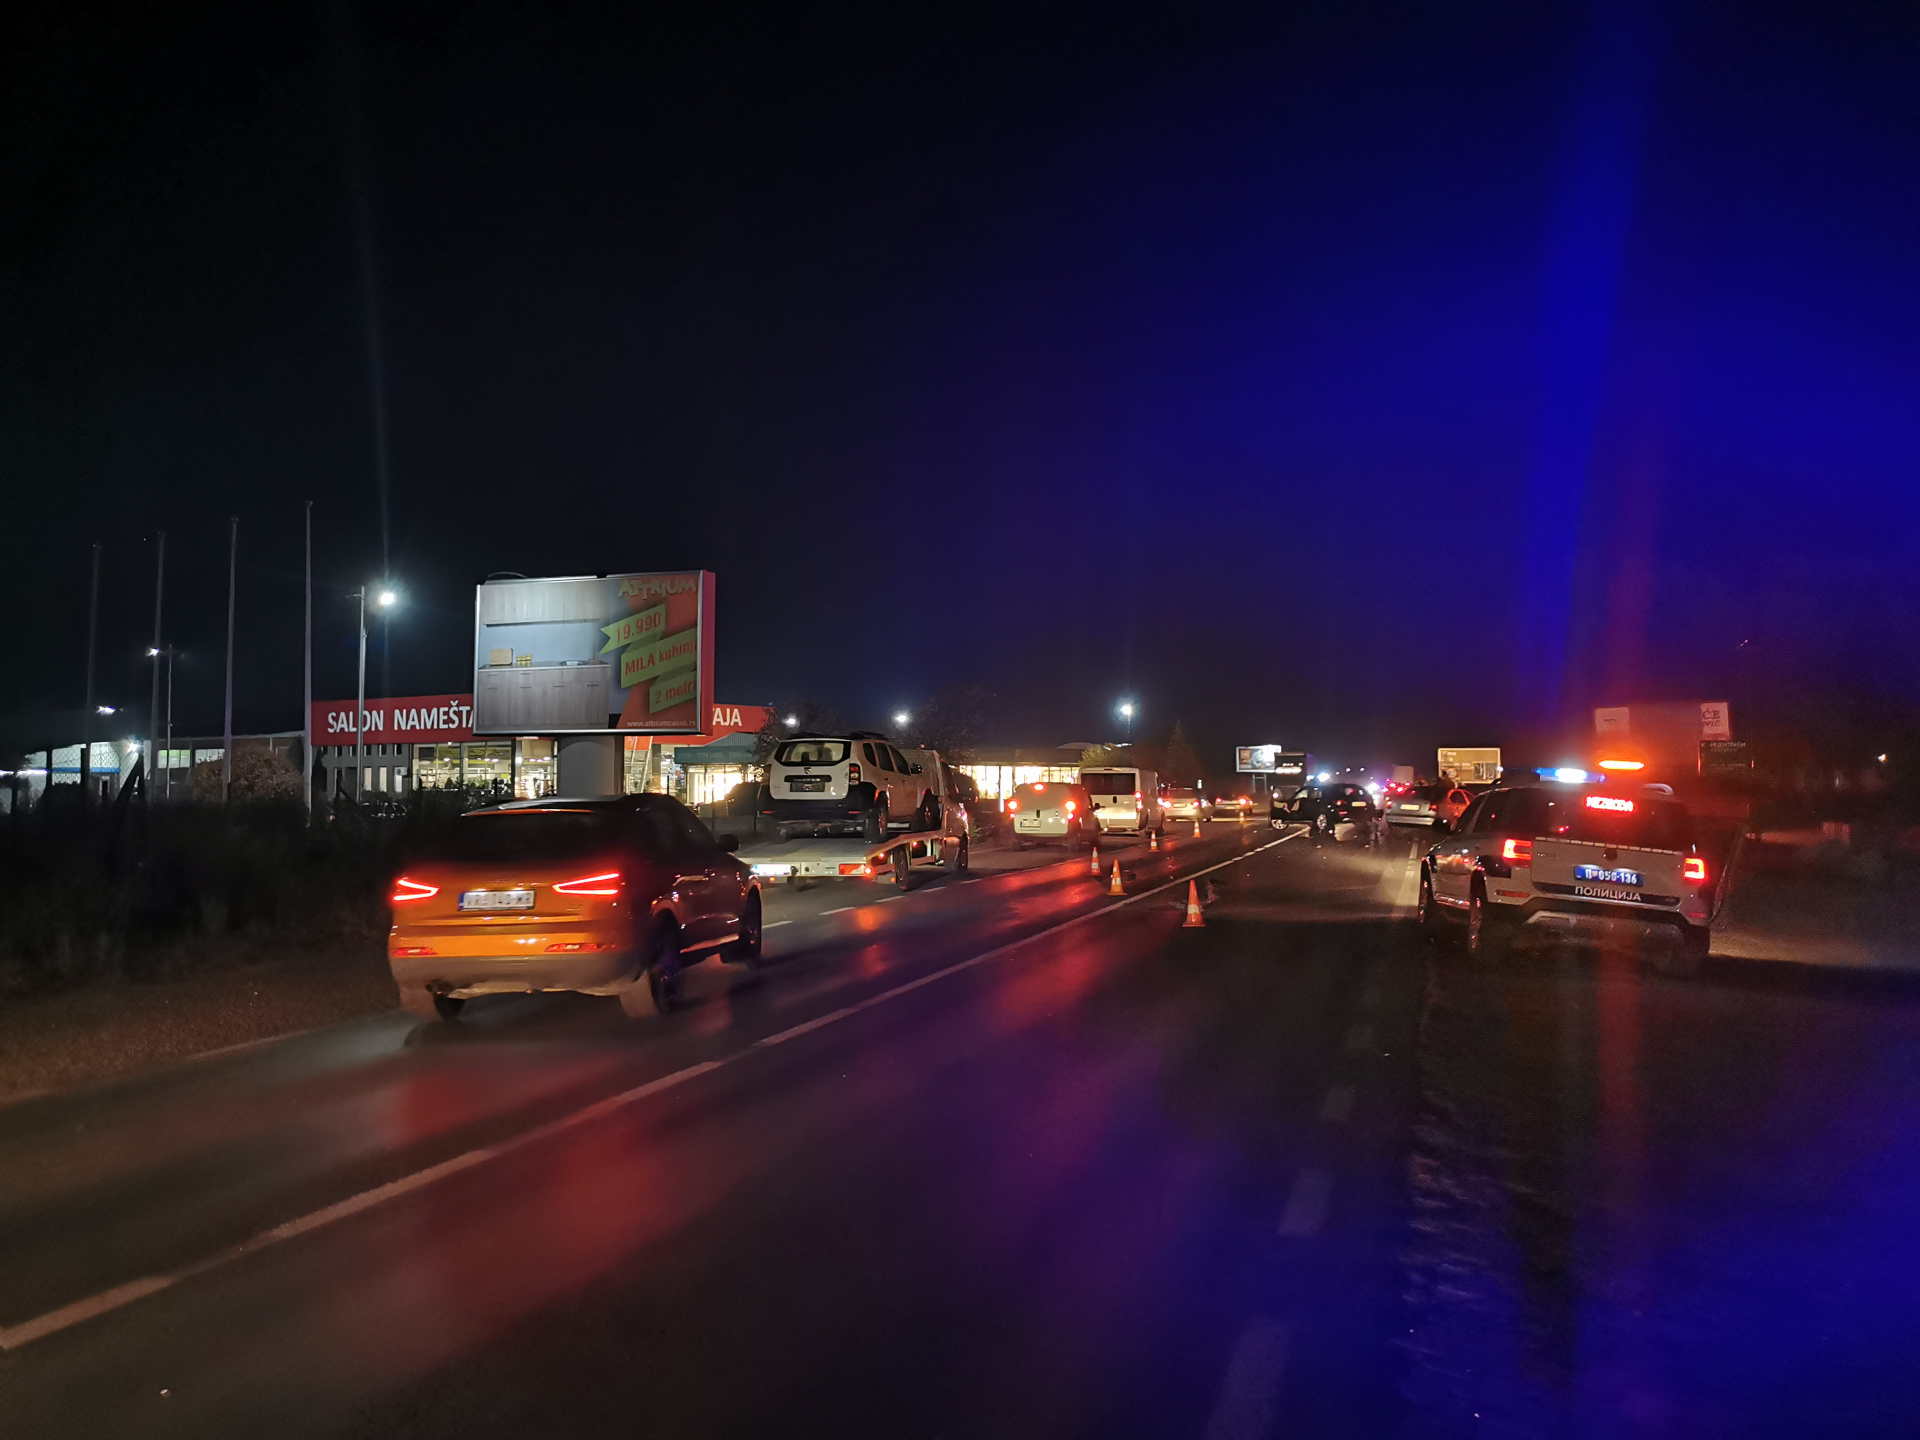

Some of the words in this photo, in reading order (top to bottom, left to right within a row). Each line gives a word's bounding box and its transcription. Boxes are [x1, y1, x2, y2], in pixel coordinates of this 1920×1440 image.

[616, 612, 661, 643] 19.990
[625, 653, 655, 676] MILA
[327, 709, 384, 733] SALON
[1574, 886, 1641, 901] ПОЛИЦИЈА
